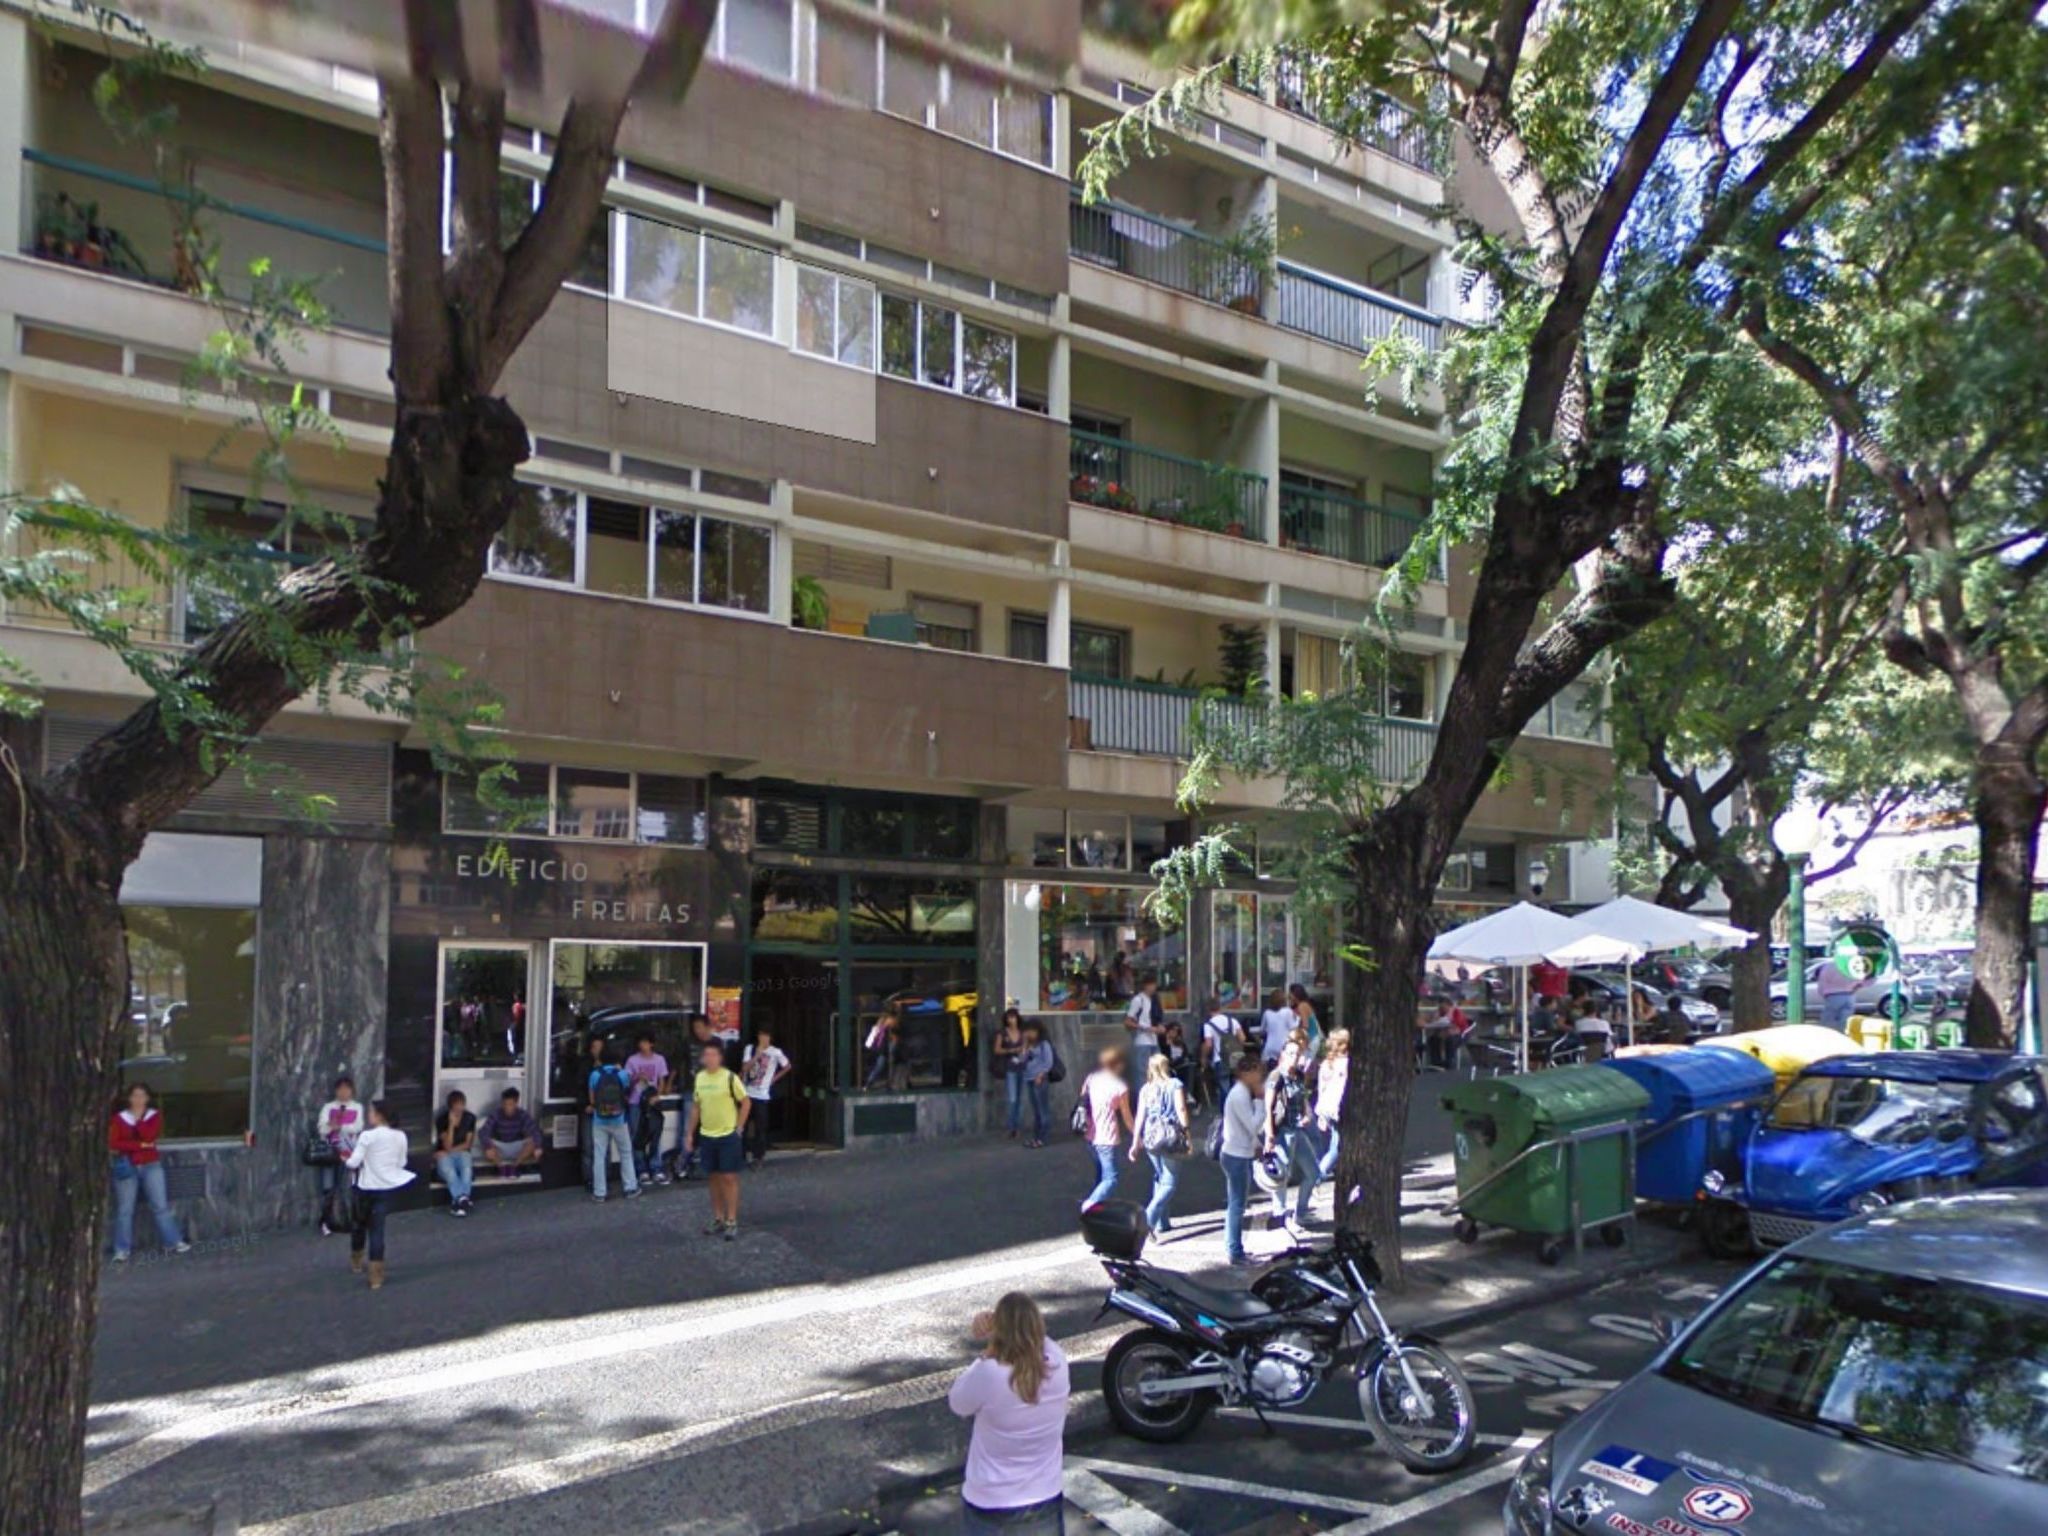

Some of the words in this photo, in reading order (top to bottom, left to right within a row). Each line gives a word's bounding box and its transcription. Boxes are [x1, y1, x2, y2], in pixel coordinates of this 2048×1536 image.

[457, 855, 588, 882] EDIFICIO
[572, 900, 690, 923] FREITAS
[1620, 1454, 1644, 1473] L
[1694, 1491, 1738, 1518] AI
